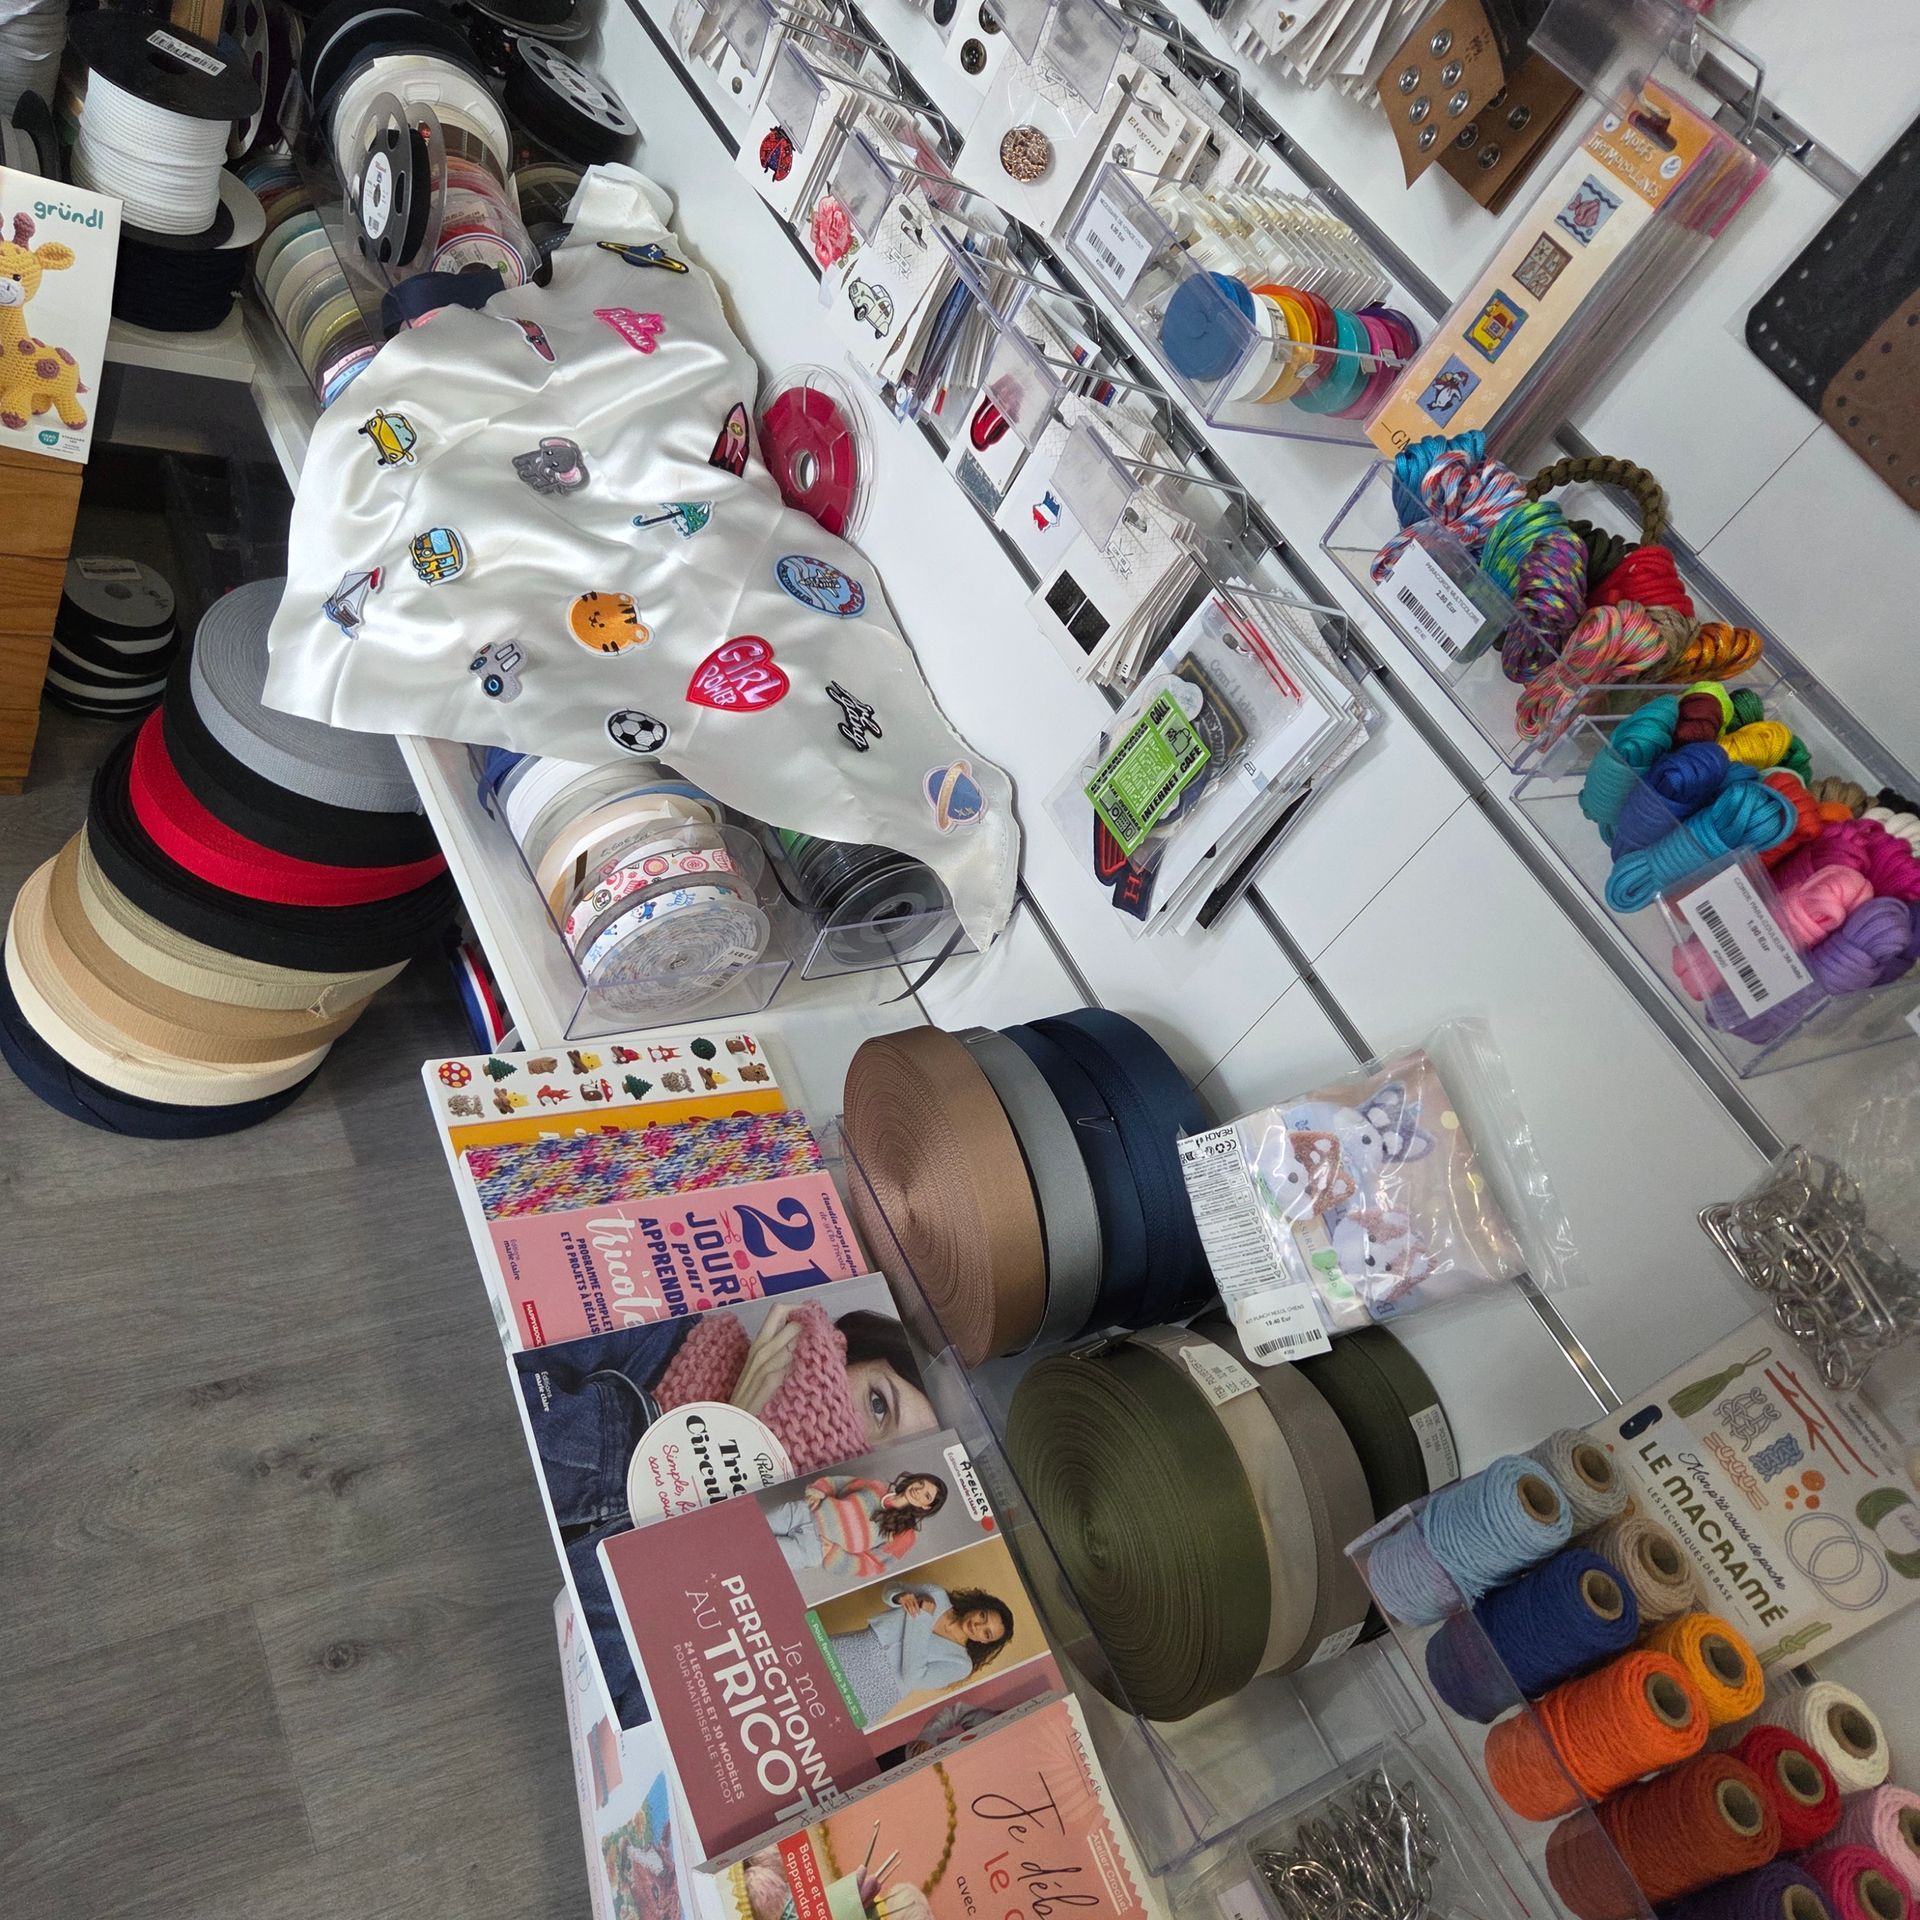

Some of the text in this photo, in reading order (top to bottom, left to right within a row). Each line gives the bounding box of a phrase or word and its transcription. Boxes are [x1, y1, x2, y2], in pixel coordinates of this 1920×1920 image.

[1128, 116, 1164, 156] Elegant
[33, 201, 104, 230] gründl
[696, 663, 738, 706] POWER
[718, 641, 781, 704] GIRL
[1150, 700, 1171, 726] CALL
[1141, 744, 1203, 823] INTERNET CAFE
[1758, 935, 1771, 952] Eur
[1205, 1126, 1234, 1142] REACH
[503, 1240, 520, 1281] marie claire
[560, 1231, 572, 1242] ET
[567, 1252, 588, 1291] PROJETS
[733, 1197, 832, 1296] 21
[834, 1224, 850, 1249] Joyal
[576, 1238, 614, 1332] PROGRAMME COMPLET
[671, 1243, 704, 1293] pour
[534, 1372, 550, 1412] marie claire
[648, 1456, 664, 1487] sans
[686, 1415, 728, 1504] Circul
[718, 1439, 748, 1496] Tric
[1638, 1441, 1672, 1476] LE
[959, 1478, 971, 1496] marie
[968, 1496, 978, 1516] claire
[1678, 1452, 1710, 1489] Mon
[1725, 1512, 1750, 1547] cours
[1749, 1541, 1762, 1558] de
[1758, 1555, 1786, 1590] poche
[1647, 1487, 1734, 1602] LES TECHNIQUES DE BASE
[685, 1589, 722, 1630] AU
[781, 1641, 826, 1718] Je me
[813, 1623, 824, 1641] Pour
[821, 1642, 837, 1671] femme
[834, 1671, 843, 1682] du
[840, 1682, 849, 1694] 34
[845, 1695, 853, 1705] au
[673, 1644, 692, 1679] POUR
[707, 1743, 718, 1760] LE
[713, 1761, 735, 1805] TRICOT
[683, 1641, 745, 1800] 24 LEÇONS ET 30 MODÈLES
[703, 1627, 814, 1822] TRICOT
[971, 1771, 1066, 1844] Je
[786, 1852, 811, 1919] apprendre
[799, 1842, 815, 1883] Bases
[811, 1886, 821, 1900] et
[956, 1875, 977, 1917] avec
[983, 1850, 1010, 1894] le
[1092, 1834, 1129, 1913] Atelier Crochet
